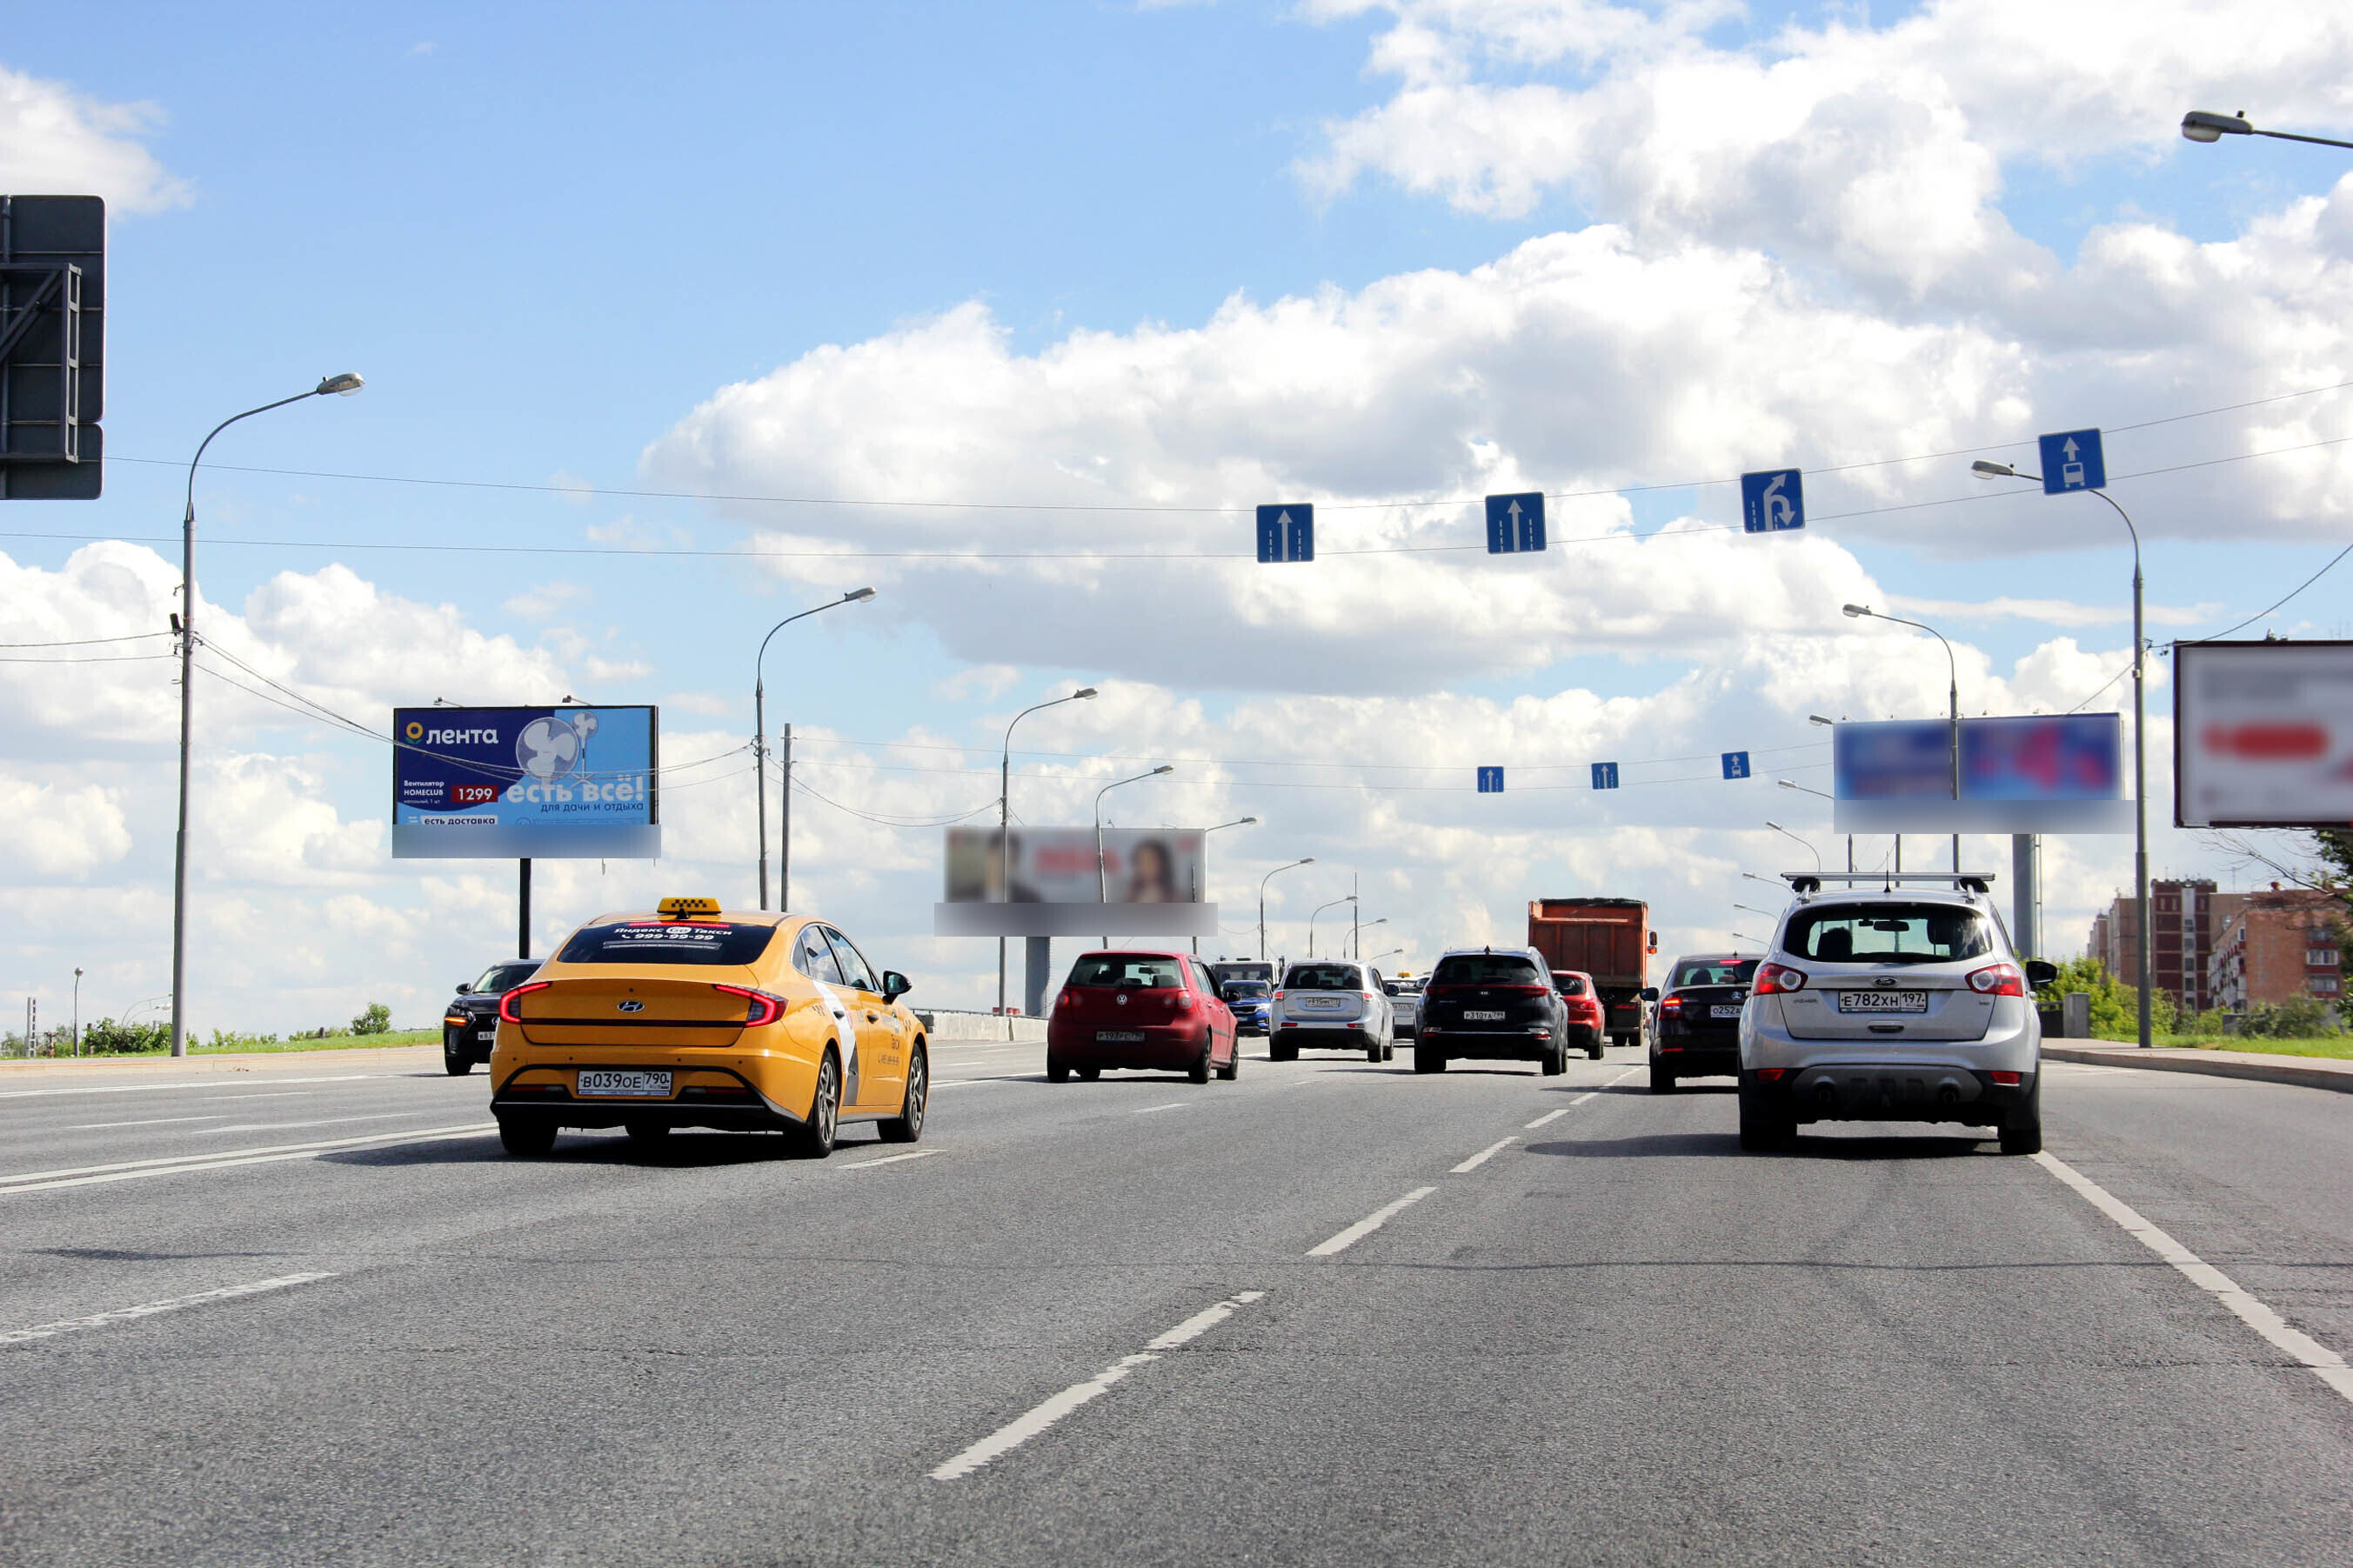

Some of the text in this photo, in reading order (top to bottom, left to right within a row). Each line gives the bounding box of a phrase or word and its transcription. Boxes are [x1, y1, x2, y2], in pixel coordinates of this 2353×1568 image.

[426, 729, 498, 744] лента
[404, 779, 445, 789] Вентилятор
[506, 775, 644, 804] есть всё!
[458, 788, 493, 800] 1299
[541, 804, 559, 814] для
[563, 803, 590, 813] дачи
[604, 802, 644, 812] отдыха
[1844, 993, 1922, 1006] Е782ХН 197
[583, 1073, 667, 1088] В039ОЕ 790
